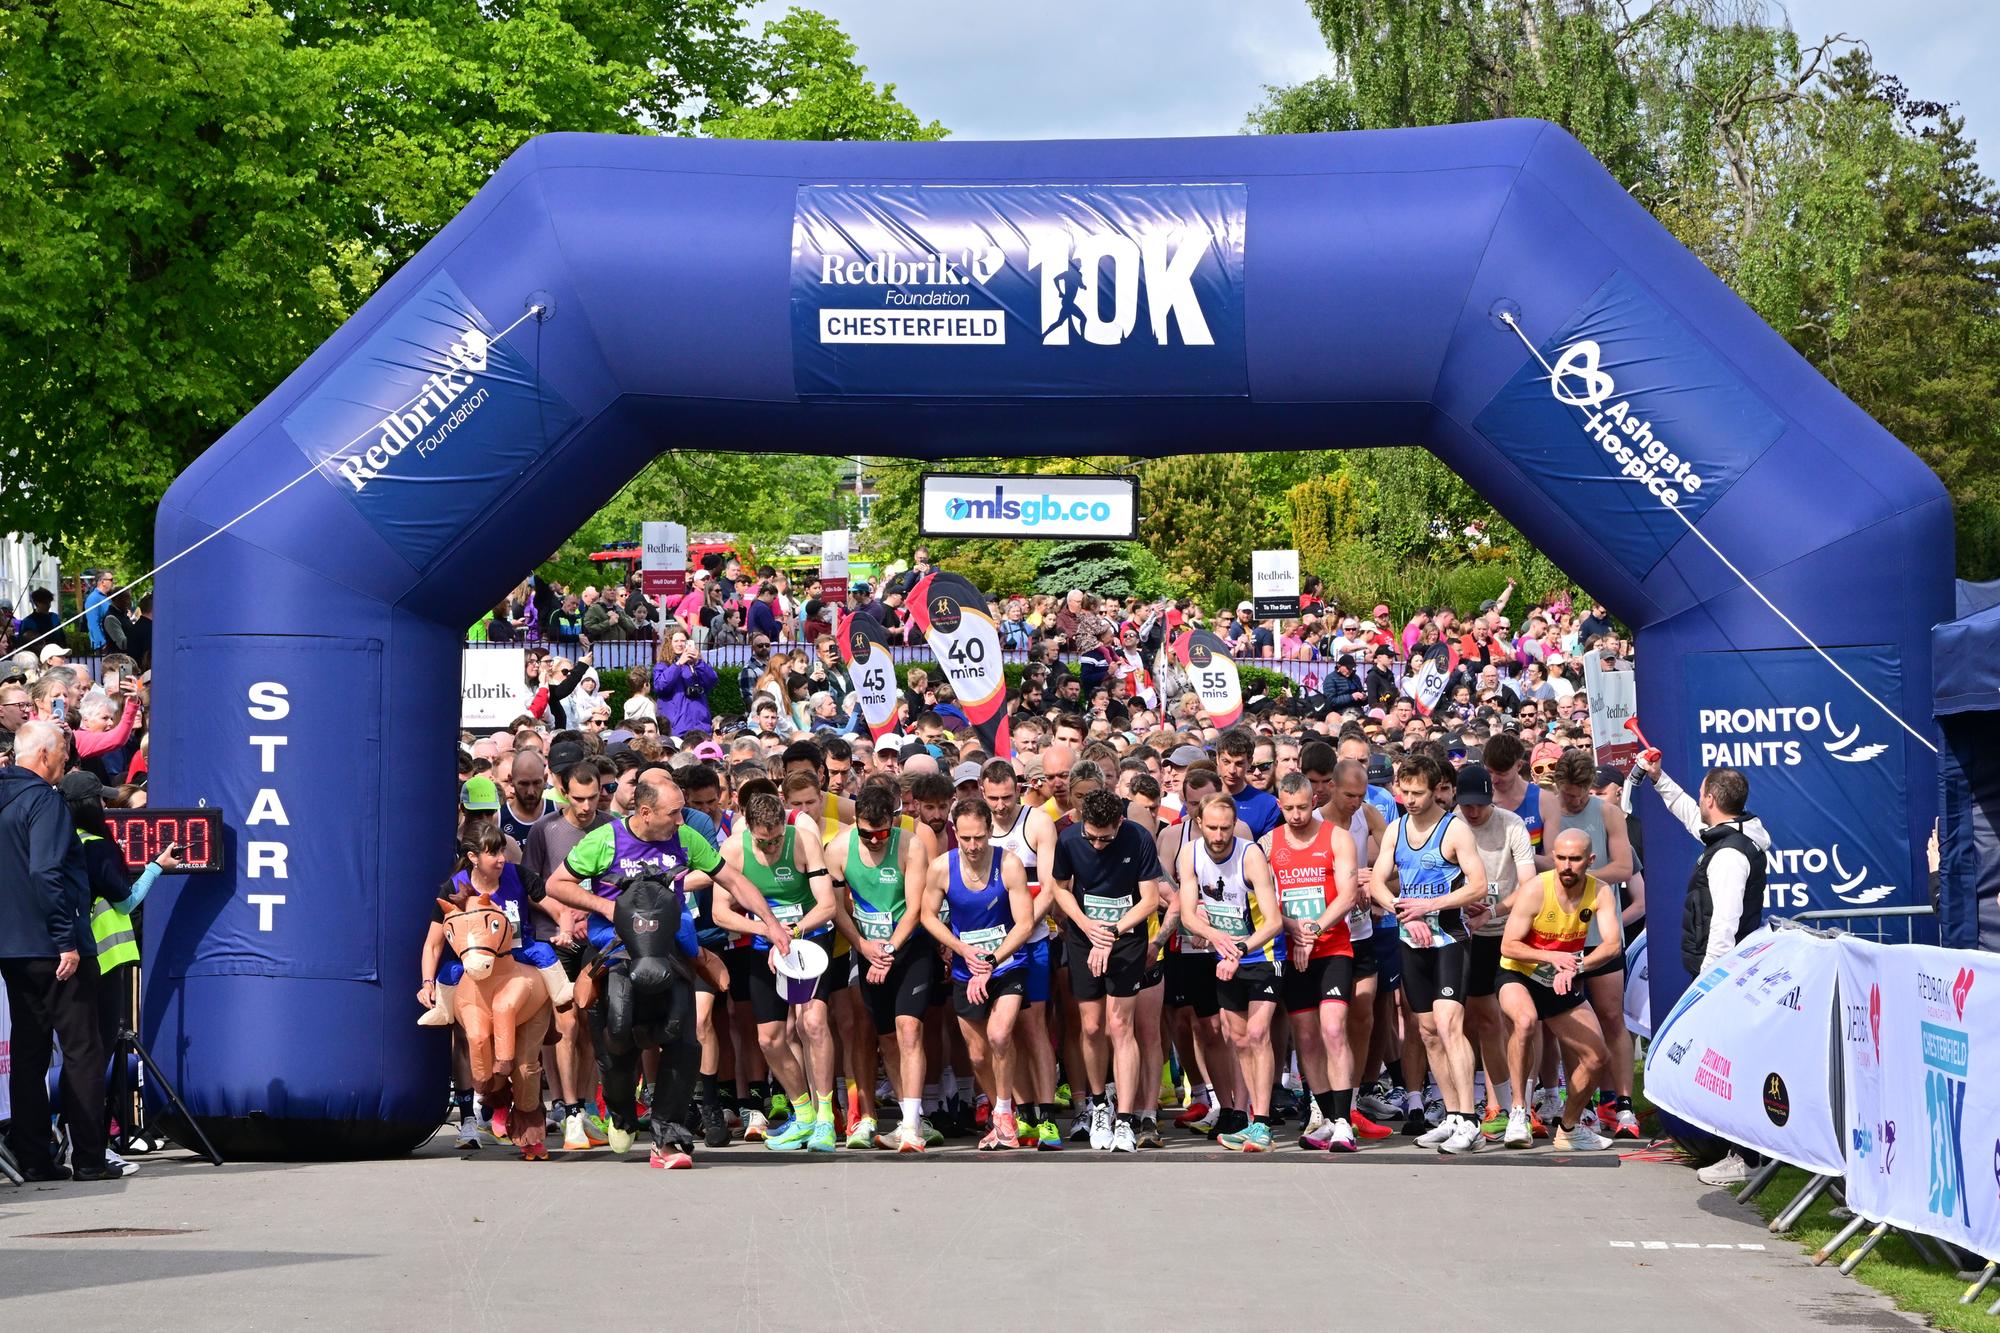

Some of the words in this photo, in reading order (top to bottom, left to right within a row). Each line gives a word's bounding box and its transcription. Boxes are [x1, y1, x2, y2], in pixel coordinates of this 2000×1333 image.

[820, 252, 970, 285] Redbrik.
[885, 290, 970, 306] Foundation
[1028, 228, 1215, 346] 10K
[827, 316, 998, 338] CHESTERFIELD
[337, 356, 474, 492] Redbrik.
[415, 387, 490, 459] Foundation
[1583, 412, 1679, 506] Hospice
[1605, 400, 1702, 494] Ashgate
[966, 485, 1111, 527] mlsgb.co
[647, 543, 683, 554] Redbrik.
[1257, 570, 1295, 581] Redbrik.
[948, 637, 985, 664] 40
[862, 668, 885, 692] 45
[950, 664, 985, 680] mins
[1202, 672, 1227, 688] 55
[1425, 674, 1443, 690] 60
[862, 692, 886, 705] mins
[1202, 688, 1228, 698] mins
[1699, 706, 1821, 734] PRONTO
[1701, 740, 1802, 768] PAINTS
[245, 681, 291, 932] START
[1278, 866, 1326, 880] CLOWNE
[1765, 848, 1828, 874] NTO
[1296, 876, 1327, 884] RUNNERS
[1922, 1030, 1968, 1067] CHESTERFIELD
[1925, 1068, 1971, 1229] 10K
